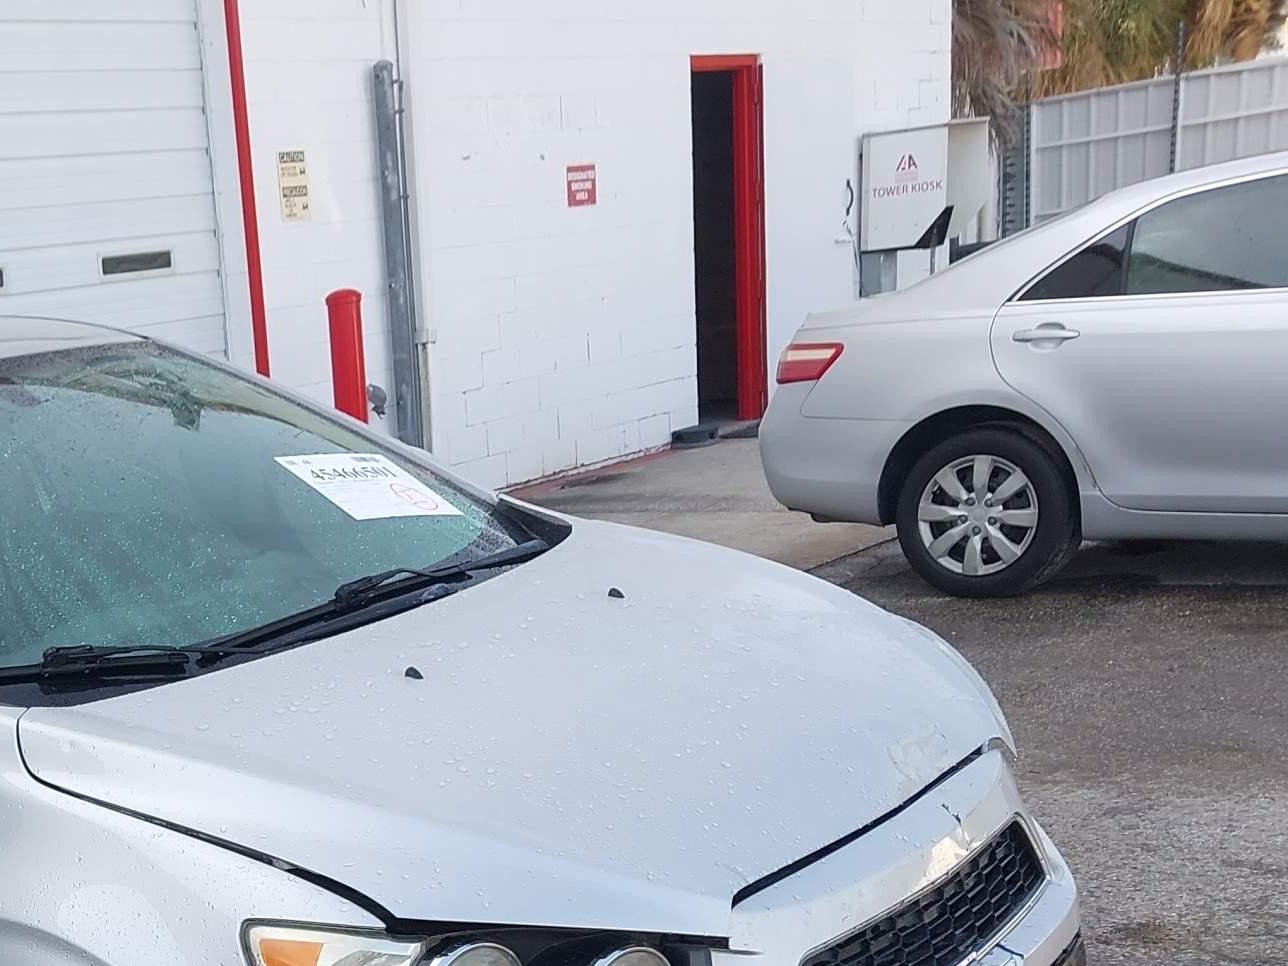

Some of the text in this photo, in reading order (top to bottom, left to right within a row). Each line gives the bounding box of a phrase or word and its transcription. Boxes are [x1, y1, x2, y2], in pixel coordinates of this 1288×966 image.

[872, 179, 943, 199] TOWER KIOSK
[310, 466, 399, 481] 45466501
